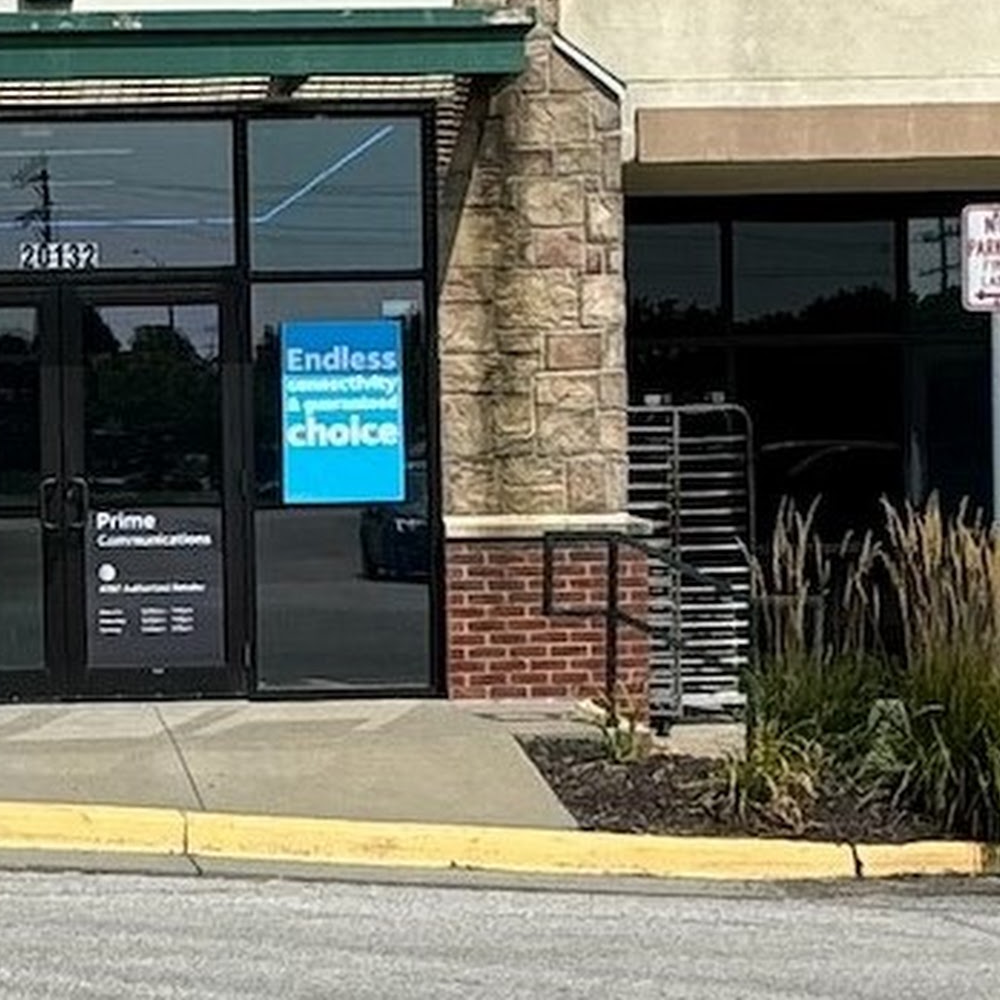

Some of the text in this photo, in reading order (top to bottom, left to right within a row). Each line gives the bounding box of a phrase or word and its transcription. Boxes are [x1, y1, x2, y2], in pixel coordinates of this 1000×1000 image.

[22, 243, 97, 272] 20132
[287, 346, 397, 372] Endless
[287, 414, 398, 447] choice
[97, 511, 157, 530] Prime
[97, 532, 212, 548] Communications
